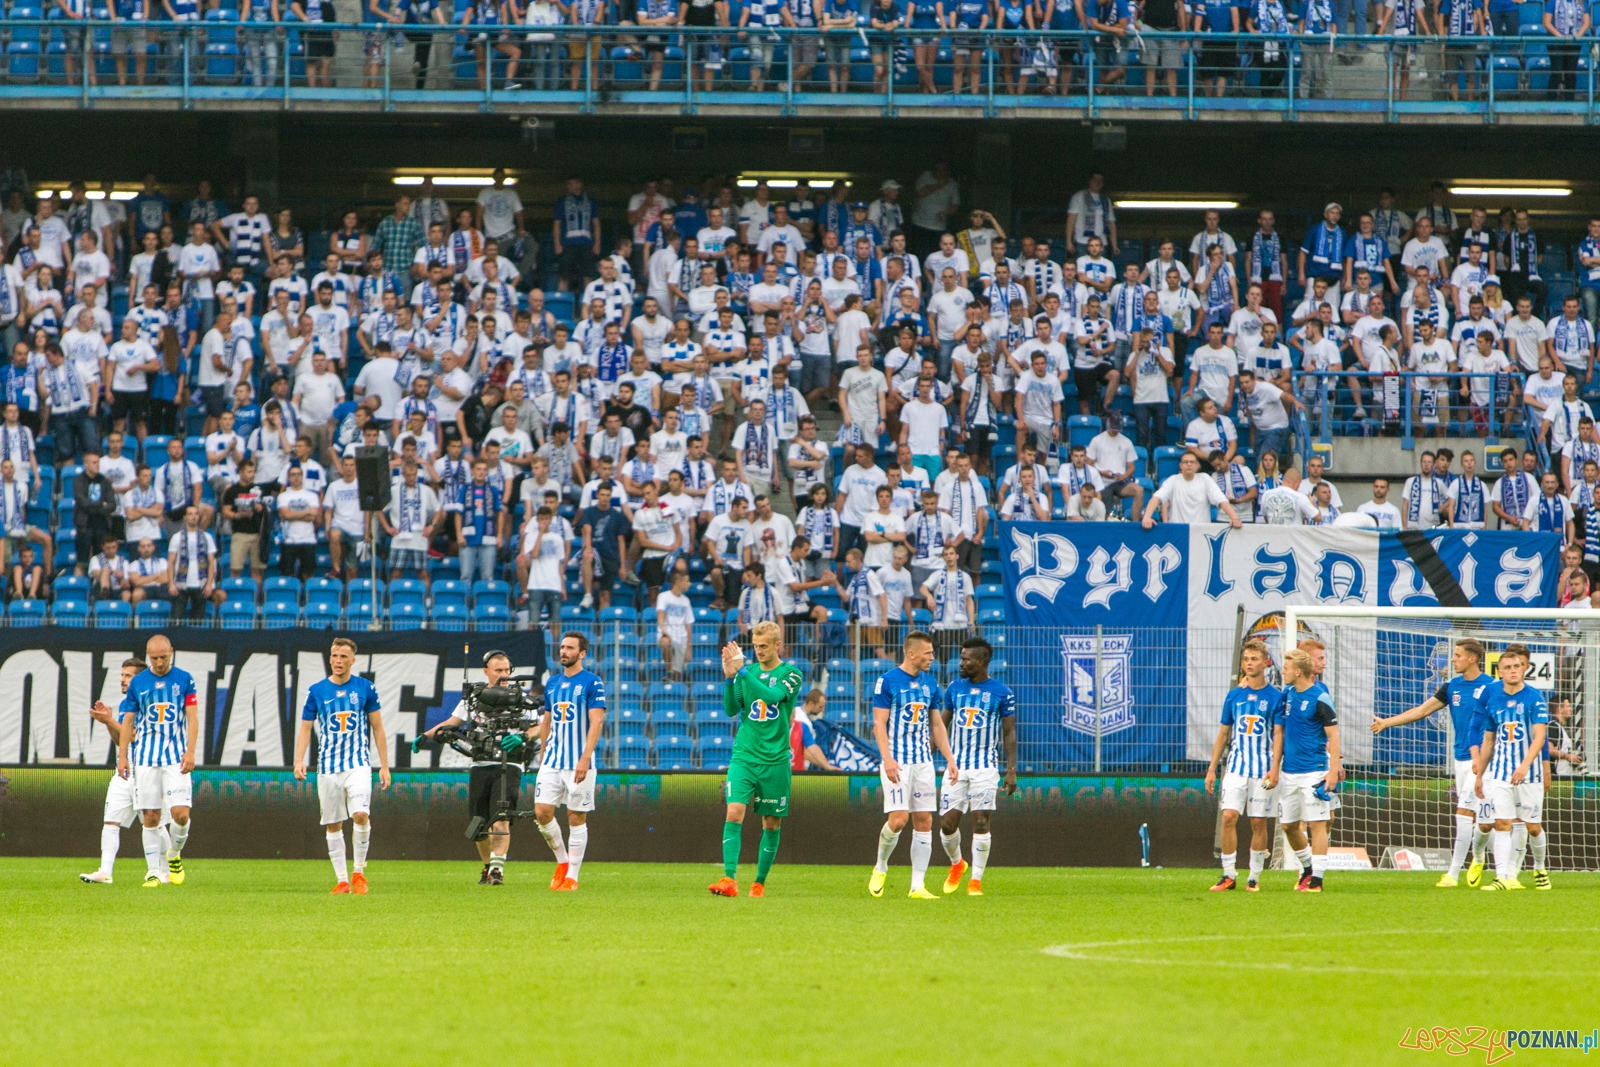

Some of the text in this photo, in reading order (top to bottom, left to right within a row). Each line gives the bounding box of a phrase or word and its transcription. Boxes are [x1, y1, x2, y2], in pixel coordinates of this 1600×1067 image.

[1070, 640, 1125, 651] KKS ECH
[149, 703, 177, 723] STS
[329, 711, 358, 732] STS
[553, 703, 576, 722] STS
[902, 703, 928, 723] STS
[957, 708, 986, 728] STS
[1238, 715, 1264, 735] STS
[1501, 722, 1525, 741] STS
[890, 788, 904, 805] 11
